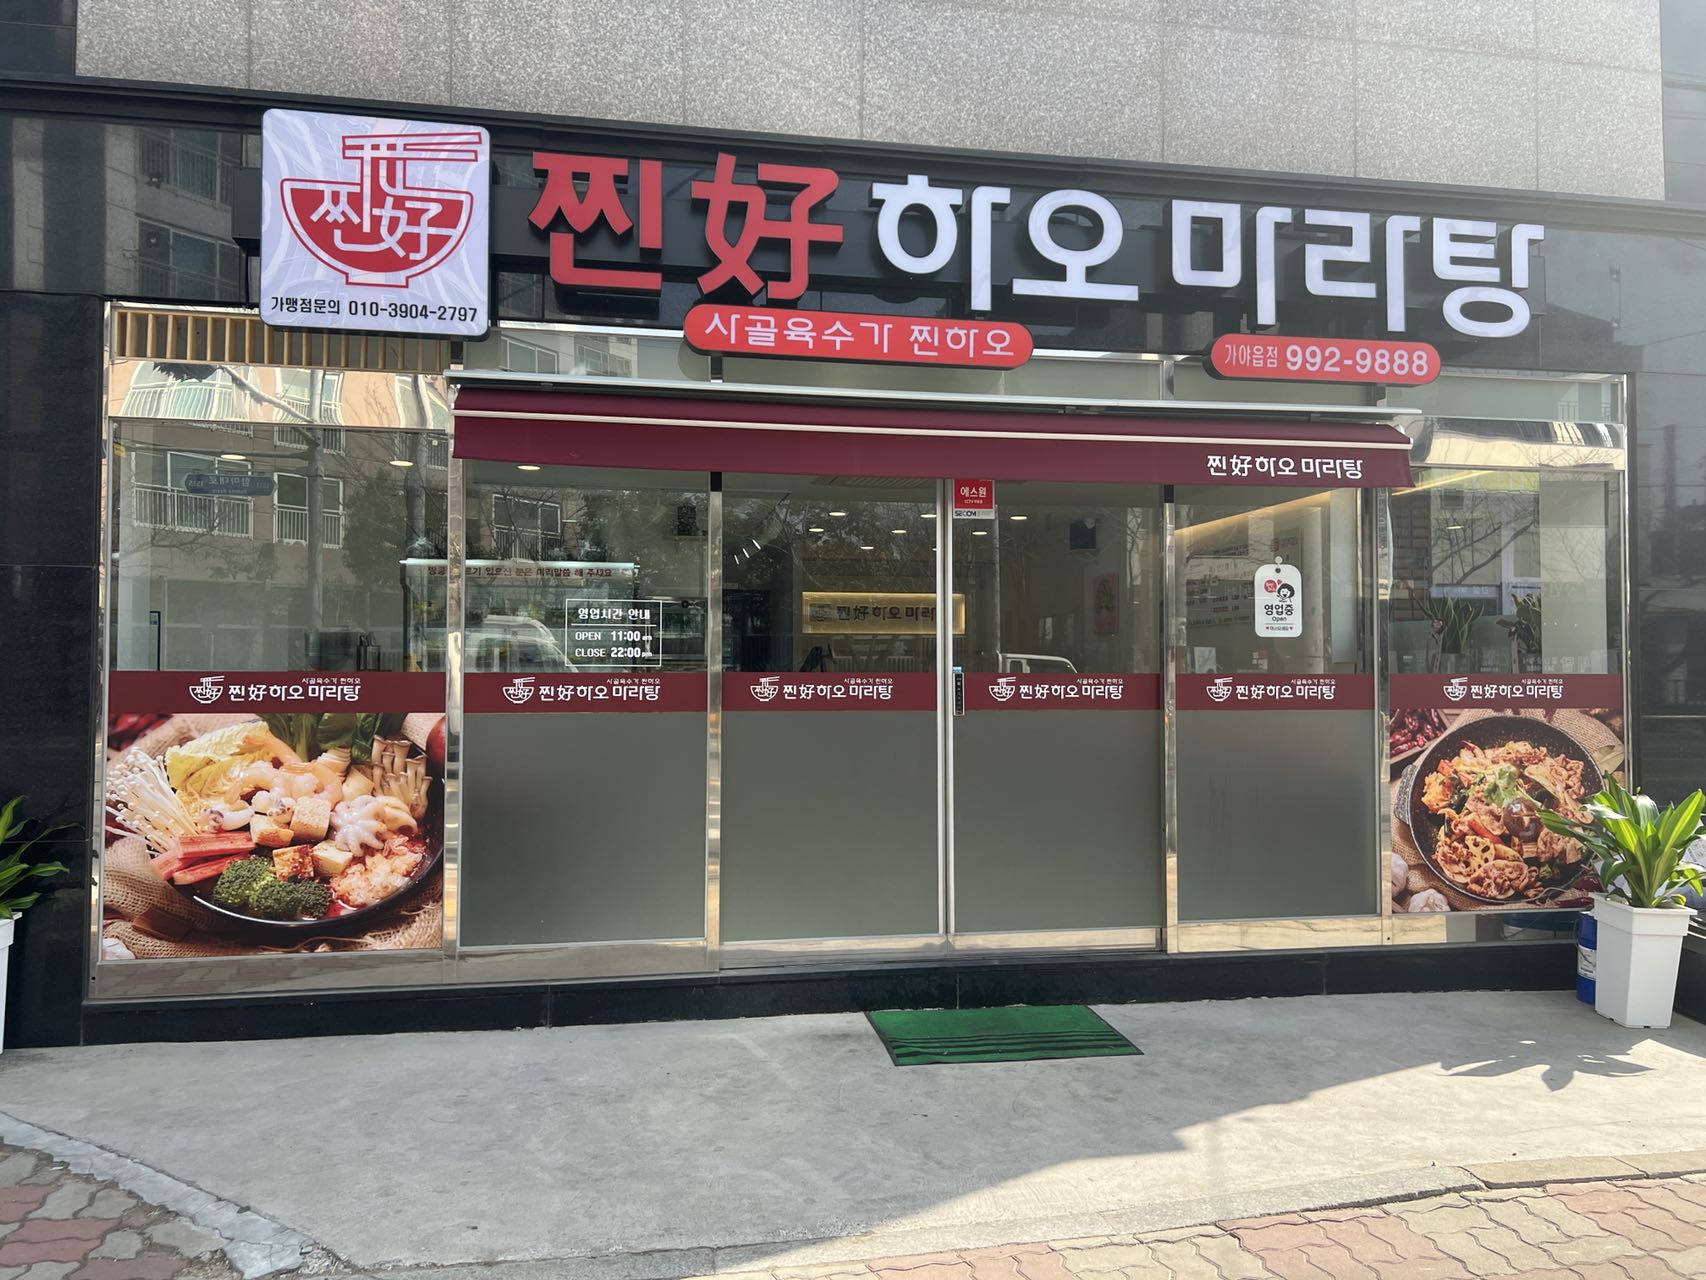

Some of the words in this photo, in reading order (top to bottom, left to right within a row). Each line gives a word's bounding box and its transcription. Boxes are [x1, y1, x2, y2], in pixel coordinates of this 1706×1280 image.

[1171, 199, 1545, 338] 마라탕
[271, 296, 341, 315] 가맹점문의
[349, 299, 478, 323] 010-3904-2797
[704, 312, 893, 353] 사골육수가
[909, 324, 1015, 358] 찐하오
[1224, 344, 1278, 369] 가야읍점
[1286, 344, 1429, 376] 992-9888
[1301, 456, 1364, 480] 마라탕
[960, 486, 987, 498] 에스원
[577, 607, 624, 620] 영업시간
[628, 608, 651, 620] 안내
[1264, 603, 1295, 616] 영업중
[575, 631, 602, 641] OPEN
[610, 630, 641, 642] 11:00
[575, 648, 607, 658] CLOSE
[610, 647, 641, 658] 22:00
[308, 685, 361, 702] 마라탕
[612, 685, 660, 701] 마라탕
[850, 685, 893, 700] 마라탕
[1082, 685, 1124, 700] 마라탕
[1296, 685, 1336, 700] 마라탕
[1526, 685, 1564, 699] 마라탕
